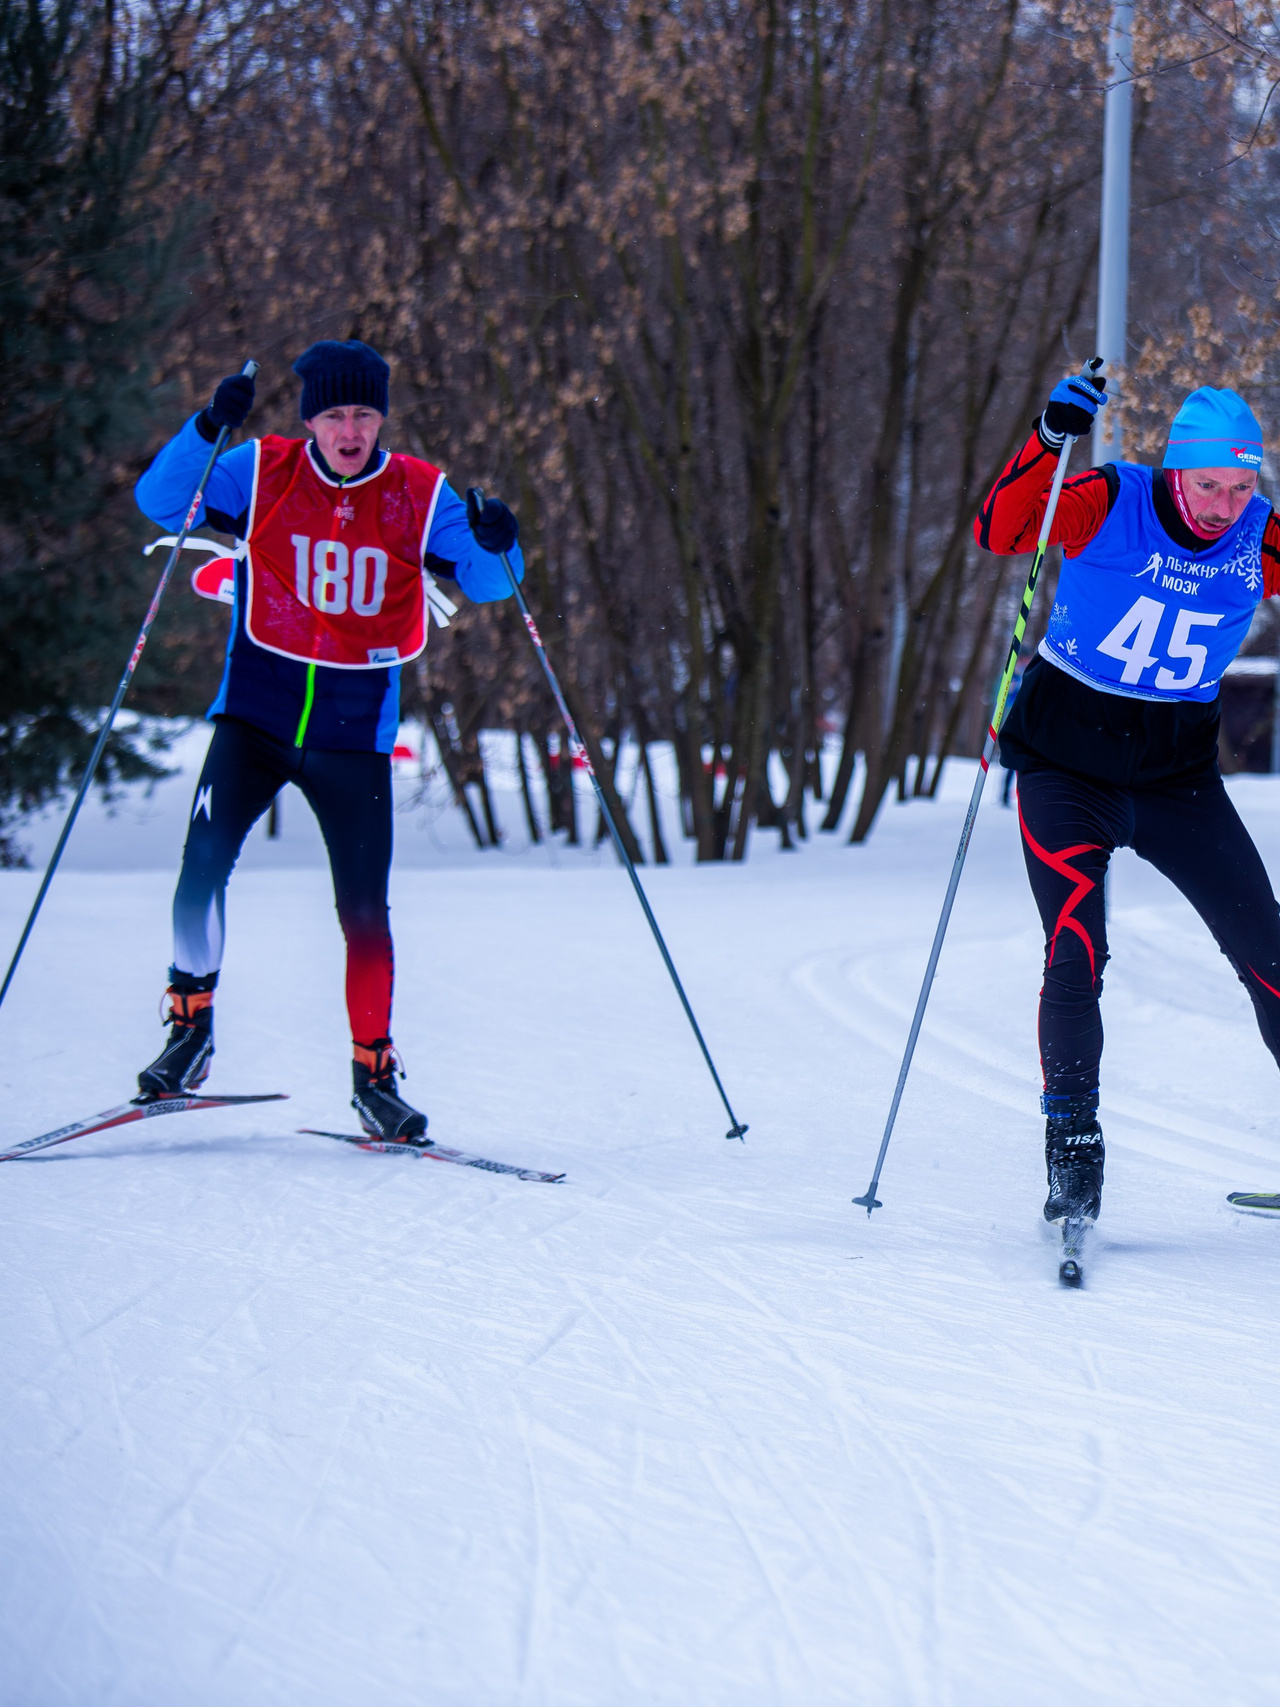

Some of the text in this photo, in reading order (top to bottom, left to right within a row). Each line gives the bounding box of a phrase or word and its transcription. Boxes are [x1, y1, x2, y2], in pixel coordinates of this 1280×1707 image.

[291, 533, 389, 617] 180
[1165, 555, 1219, 579] ЛЫЖНЯ
[1161, 574, 1201, 596] МОЭК
[1096, 595, 1226, 690] 45
[1065, 1132, 1101, 1146] TISA
